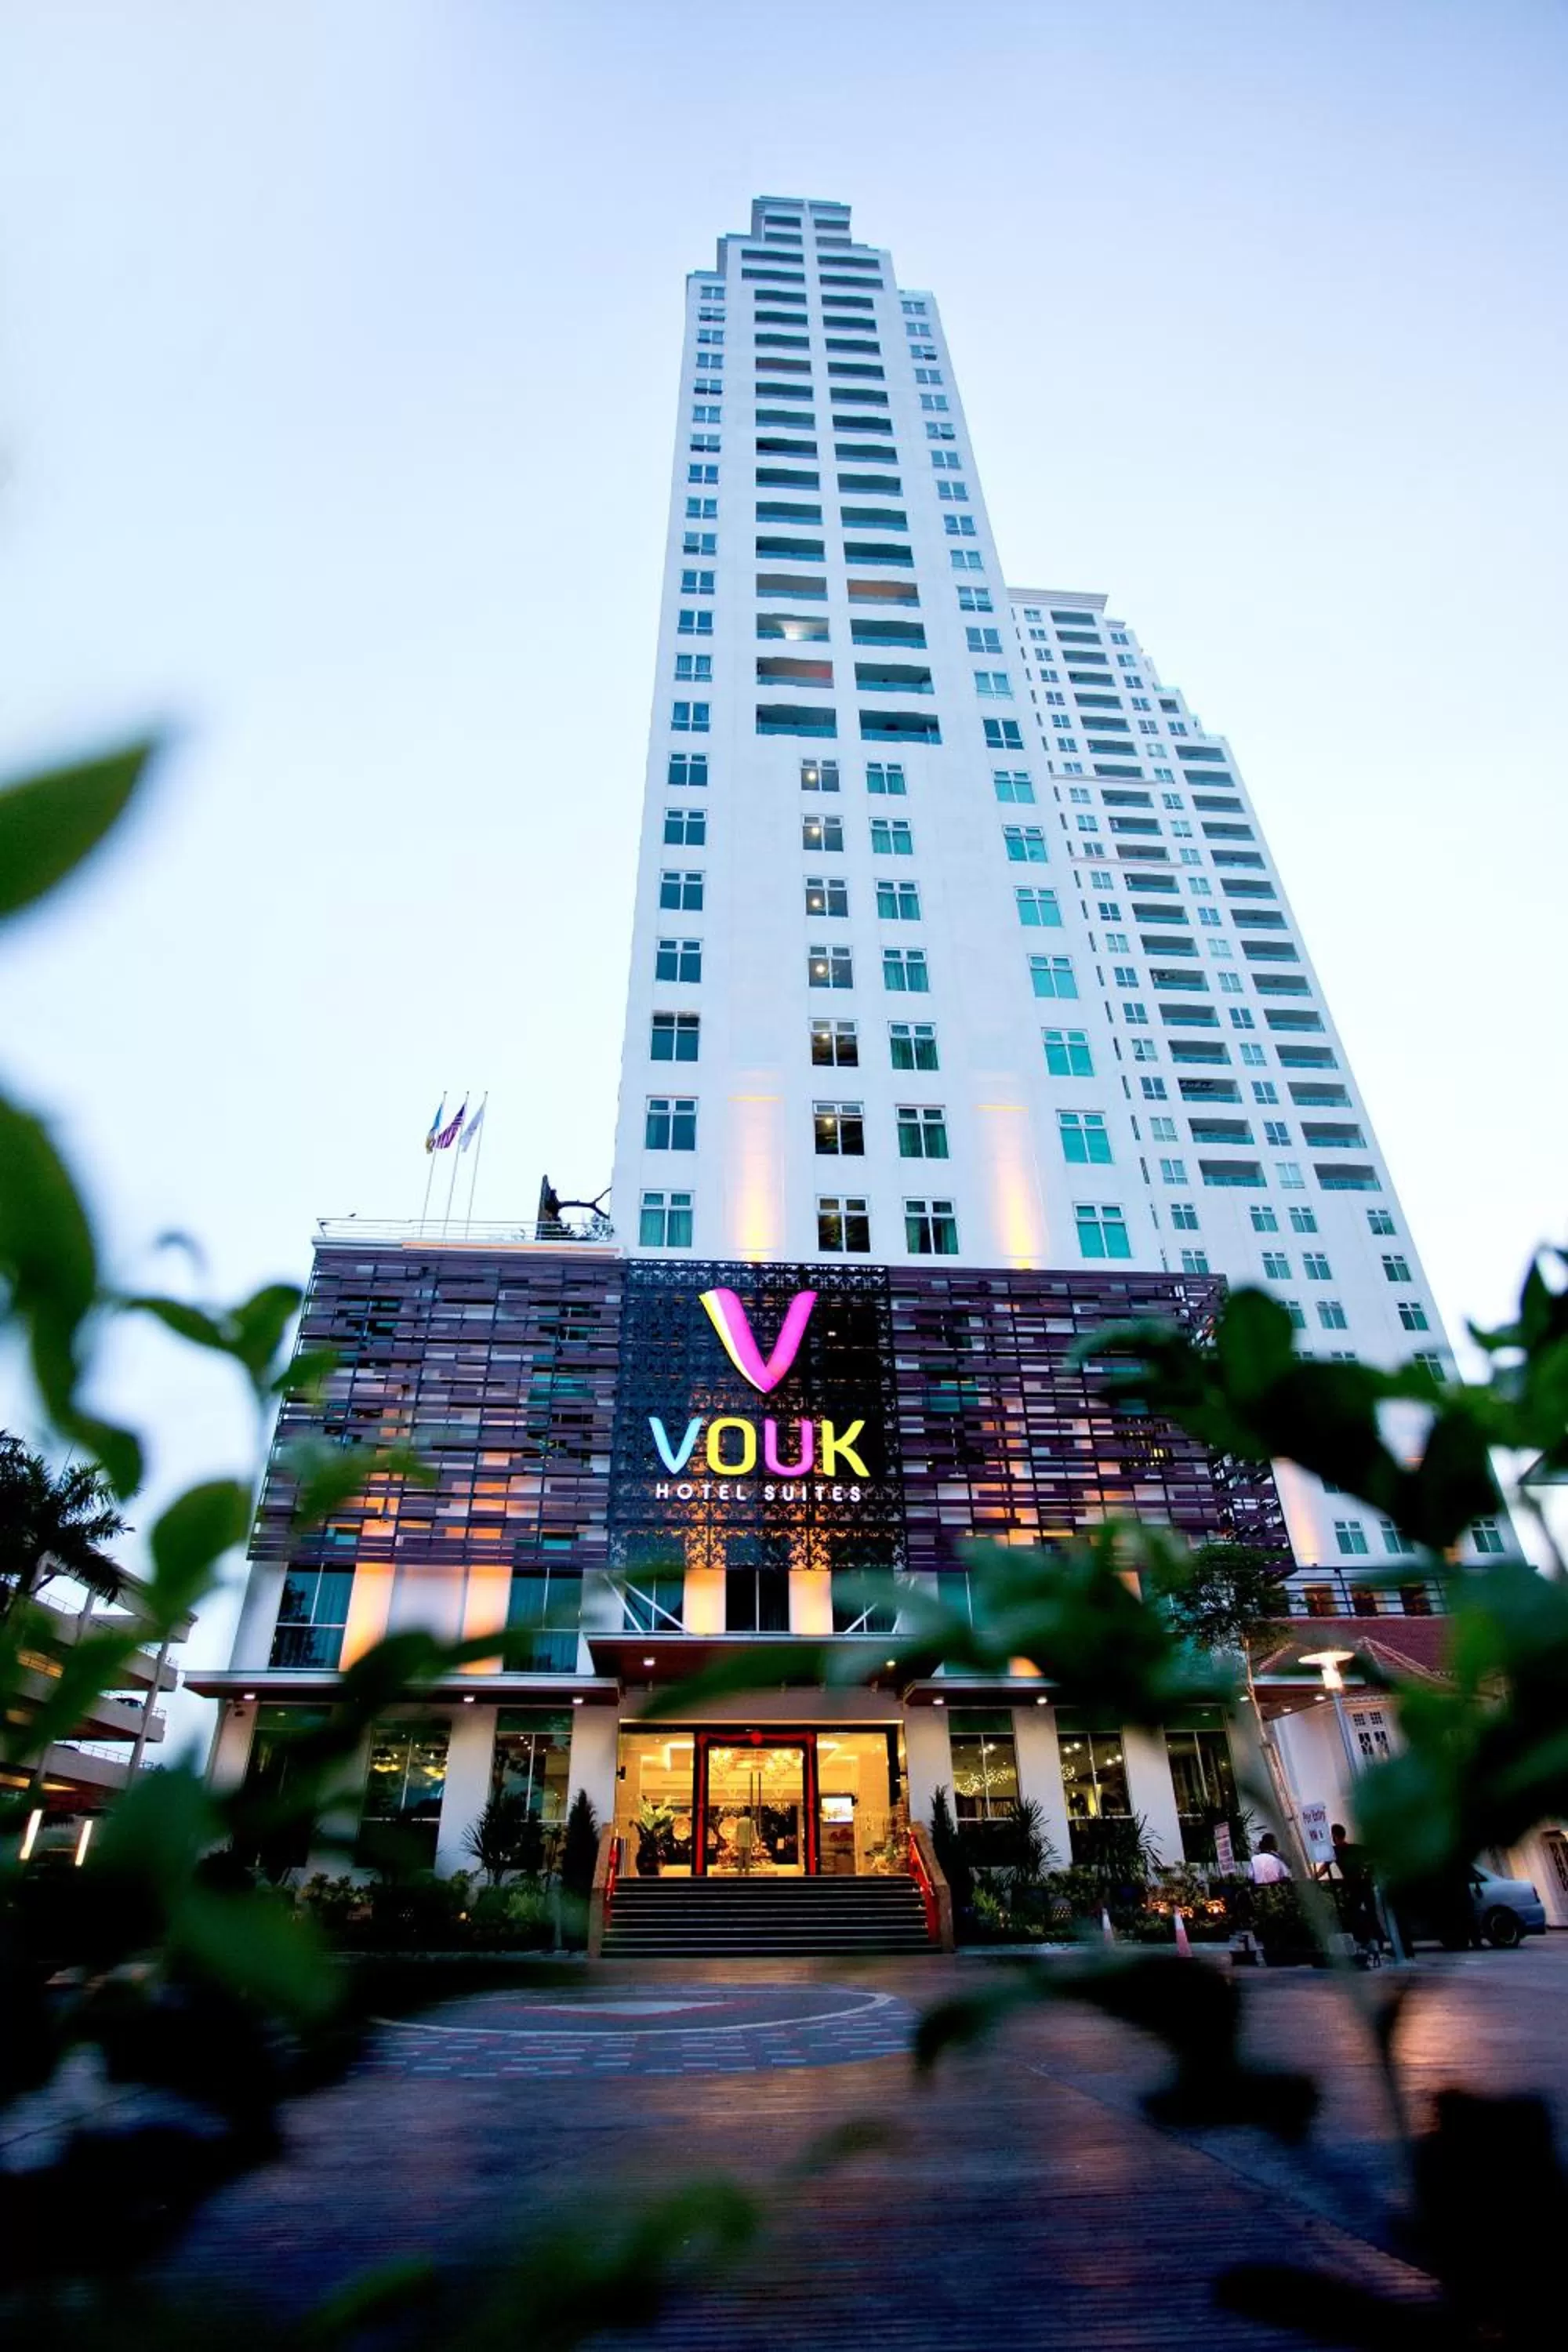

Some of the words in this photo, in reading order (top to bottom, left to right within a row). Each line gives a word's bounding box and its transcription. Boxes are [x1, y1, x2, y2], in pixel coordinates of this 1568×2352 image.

[699, 1287, 818, 1393] V
[648, 1417, 870, 1477] VOUK
[655, 1483, 747, 1501] HOTEL
[764, 1485, 862, 1502] SUITES
